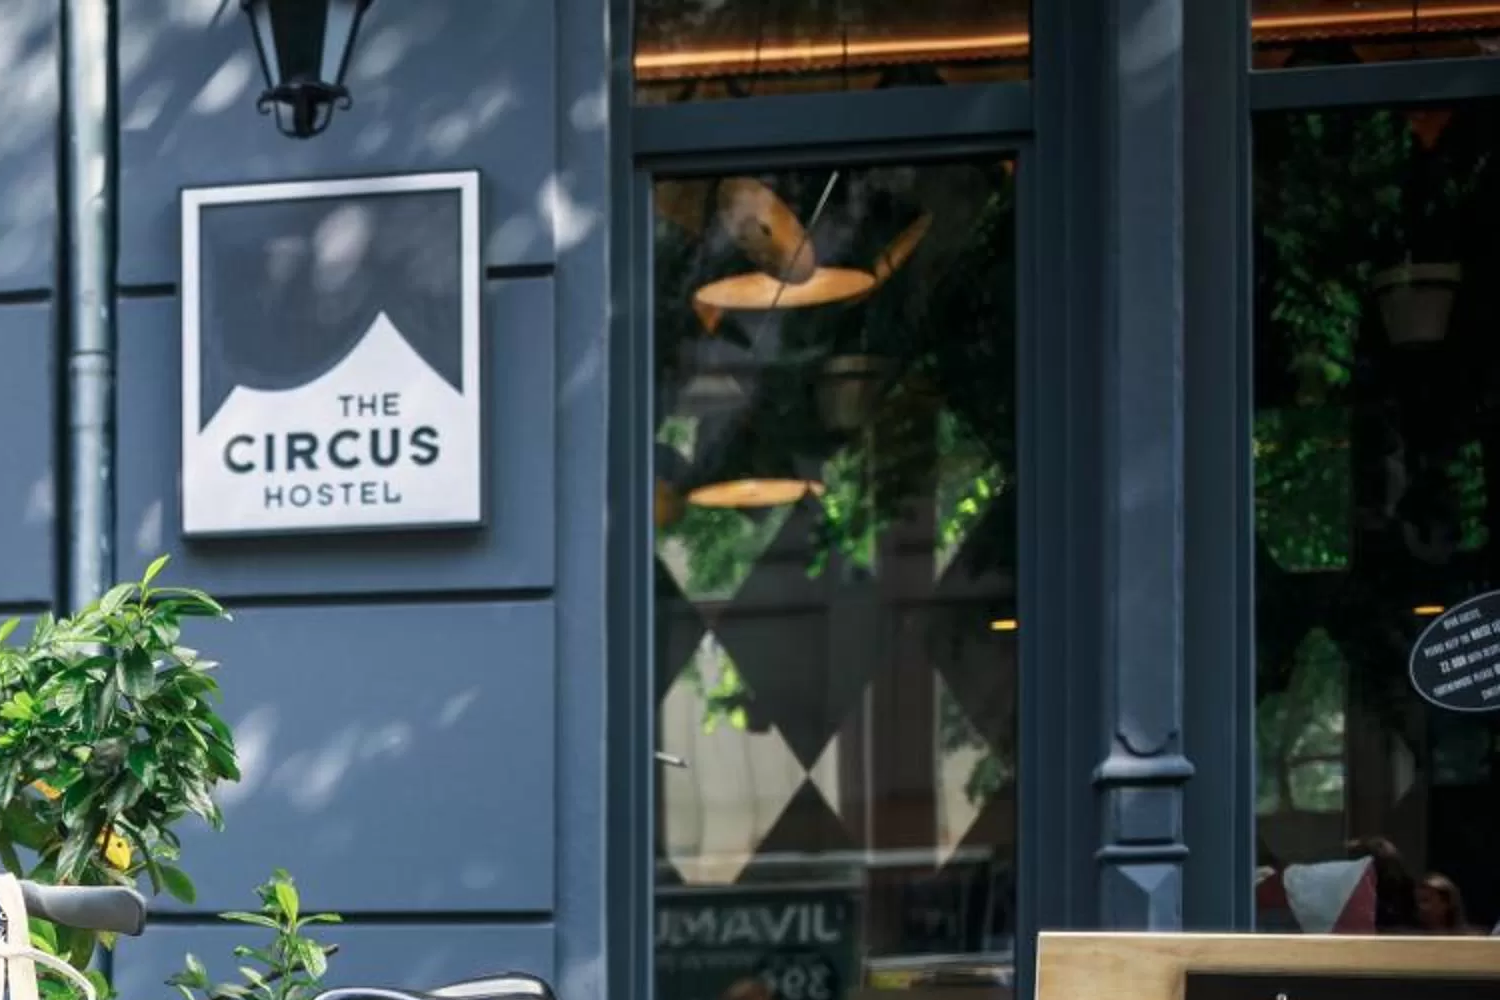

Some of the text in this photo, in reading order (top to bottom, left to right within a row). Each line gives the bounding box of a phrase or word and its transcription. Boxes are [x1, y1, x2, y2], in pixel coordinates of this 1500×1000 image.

[338, 393, 401, 417] THE
[223, 426, 440, 474] CIRCUS
[264, 481, 403, 509] HOSTEL
